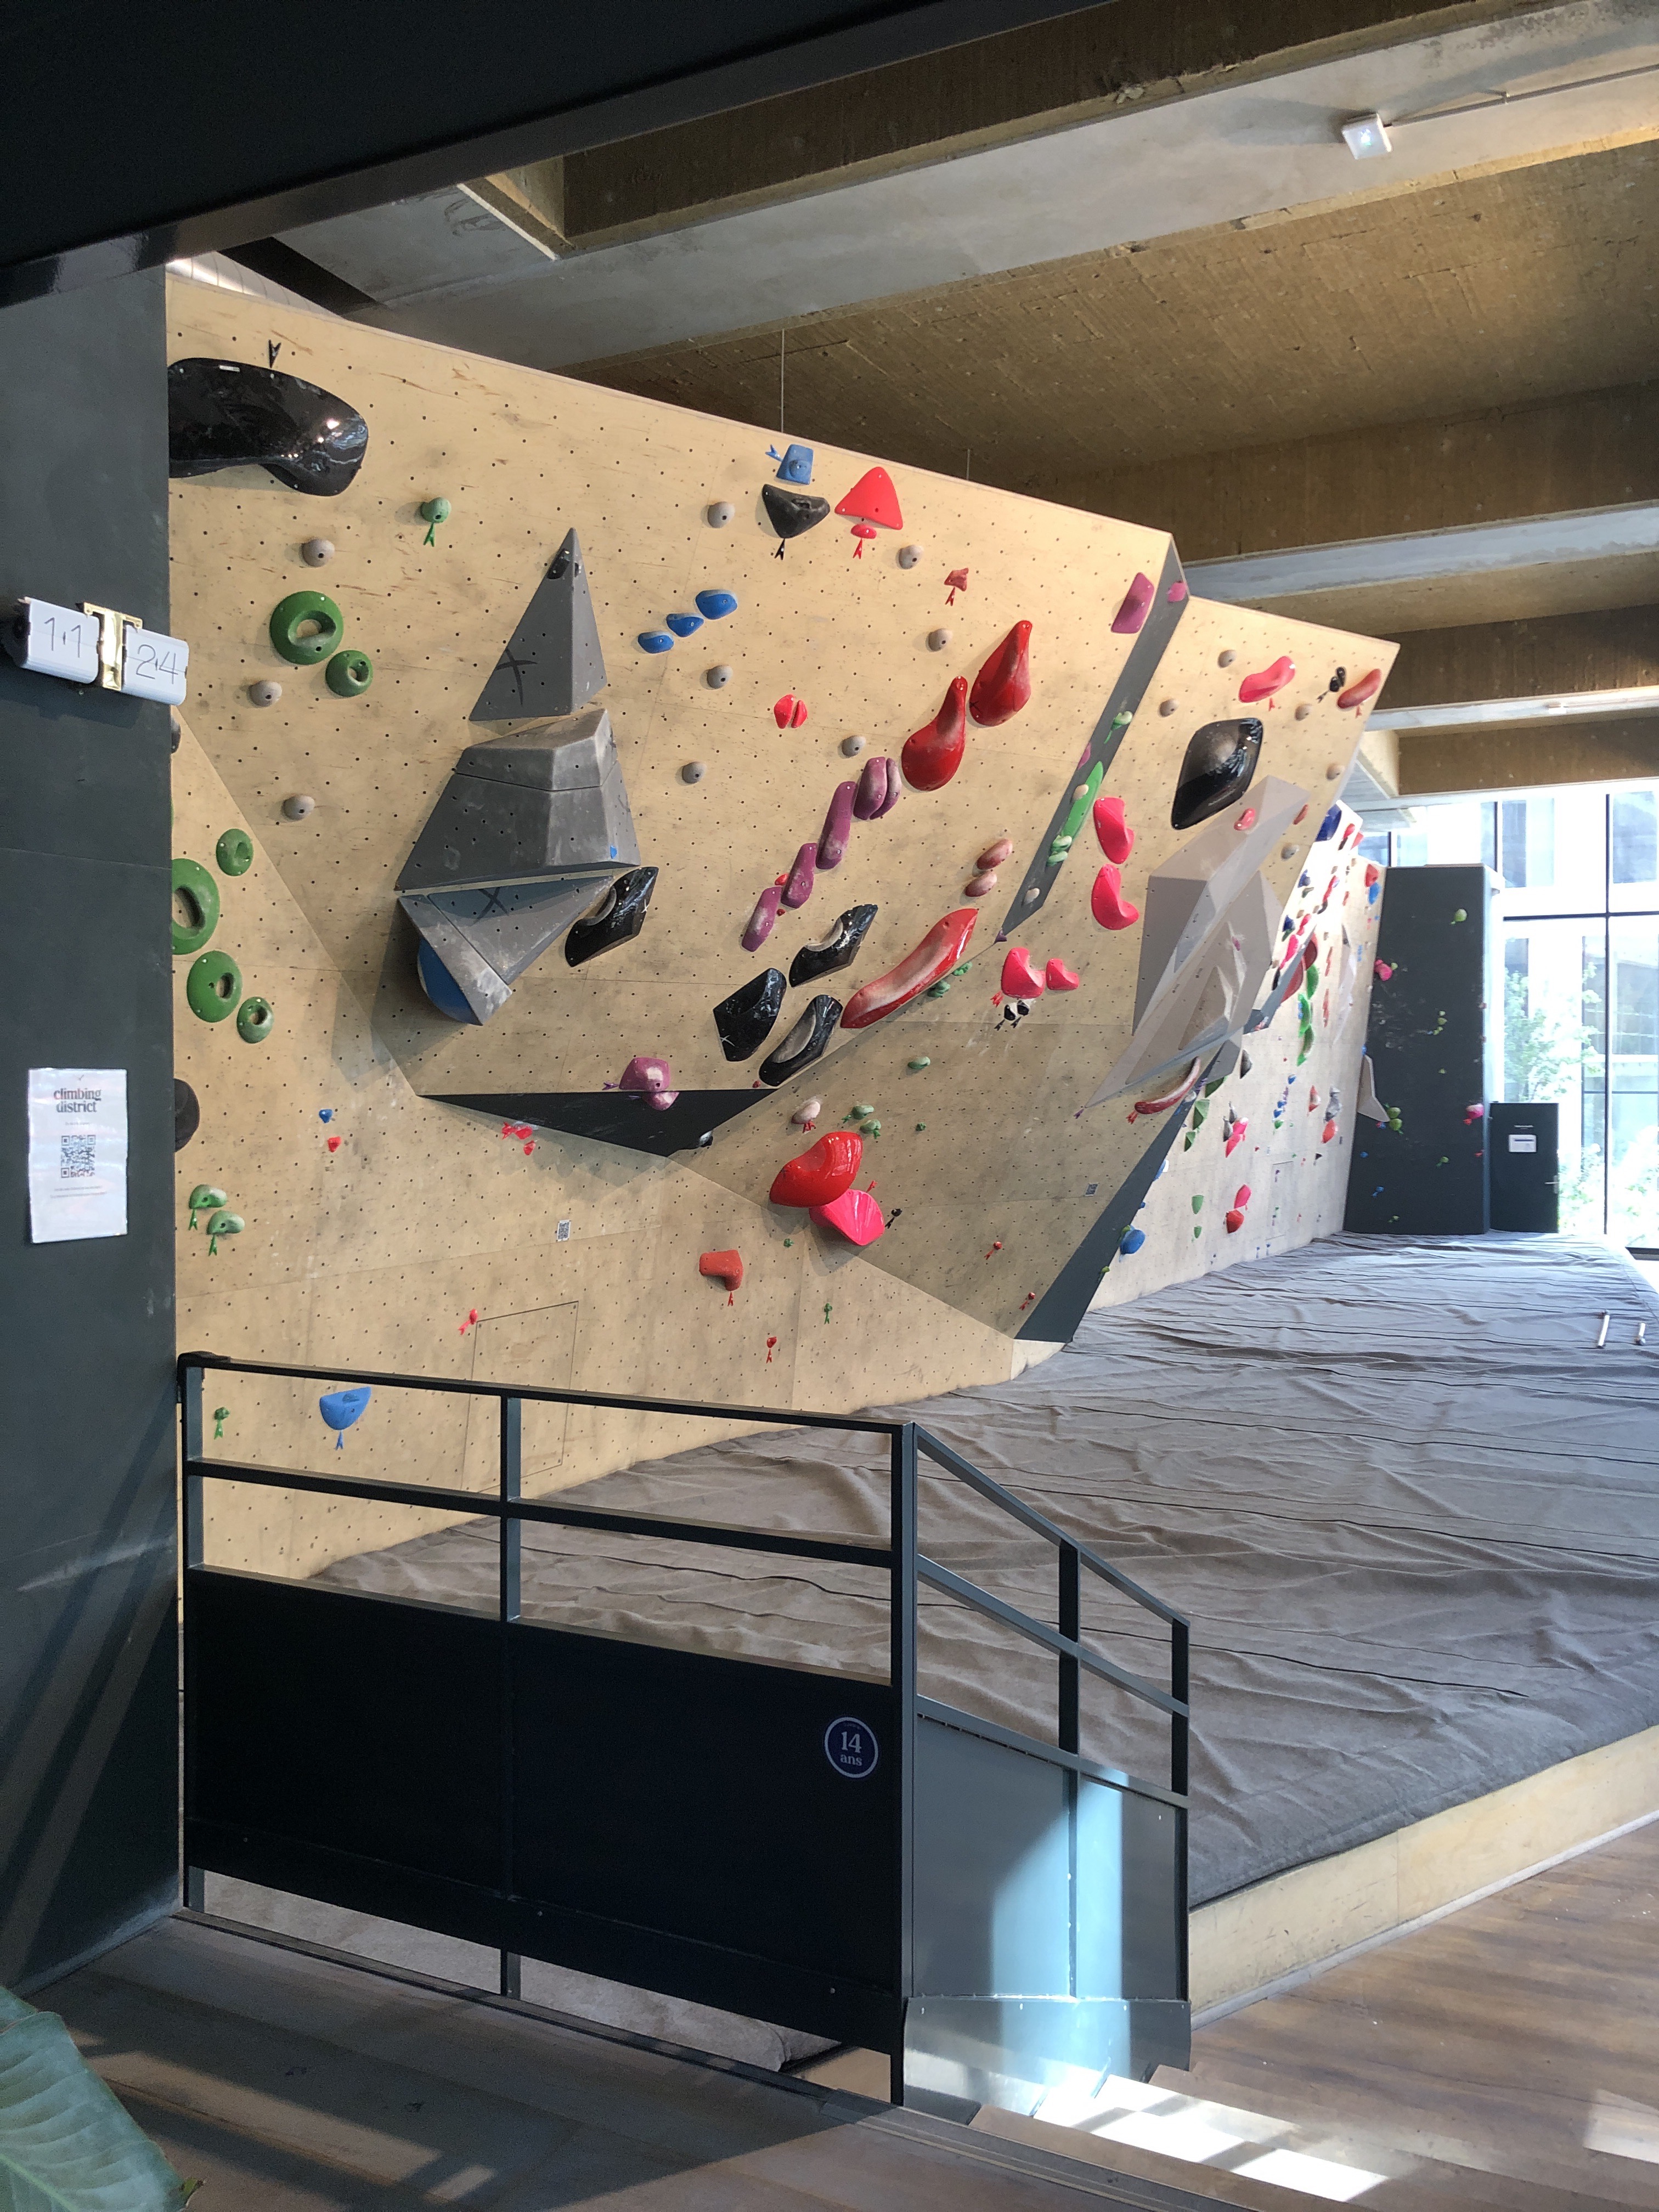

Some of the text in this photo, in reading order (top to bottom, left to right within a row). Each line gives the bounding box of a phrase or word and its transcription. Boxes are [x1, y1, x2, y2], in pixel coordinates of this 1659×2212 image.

[136, 644, 178, 685] 24
[53, 1088, 101, 1101] climbing
[56, 1101, 97, 1113] district
[841, 1731, 862, 1753] 14
[840, 1754, 862, 1766] ans
